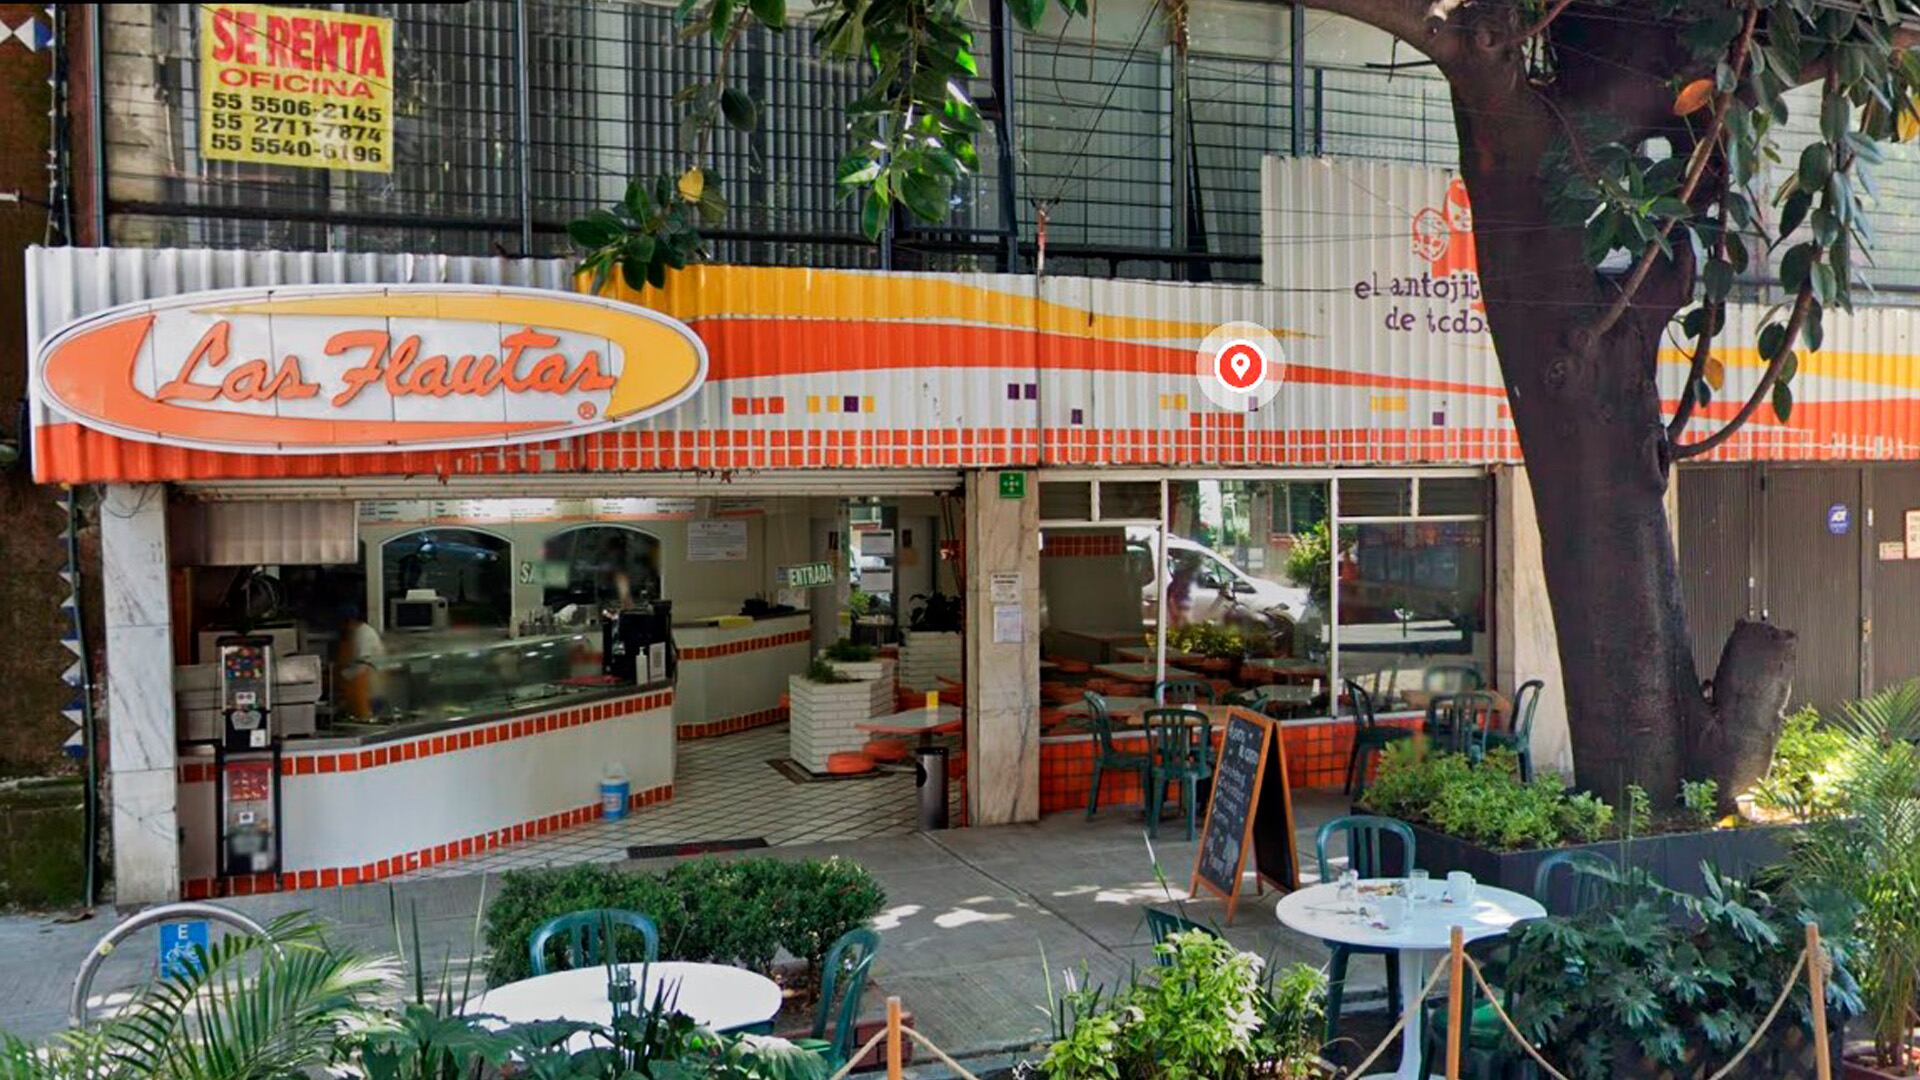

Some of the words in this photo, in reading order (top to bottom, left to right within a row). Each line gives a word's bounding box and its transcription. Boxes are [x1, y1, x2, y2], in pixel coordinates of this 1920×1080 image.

[212, 8, 257, 65] SE
[267, 15, 386, 78] RENTA
[219, 68, 374, 99] OFICINA
[212, 92, 242, 110] 55
[251, 95, 382, 122] 5506-2145
[212, 113, 242, 130] 55
[254, 116, 382, 143] 2711-7874
[212, 133, 242, 151] 55
[251, 137, 382, 163] 5540-6196
[1354, 271, 1381, 299] el
[1390, 271, 1480, 303] antojit
[1385, 306, 1416, 331] de
[156, 321, 321, 402] Las
[324, 326, 617, 408] Flautas
[177, 924, 188, 939] E
